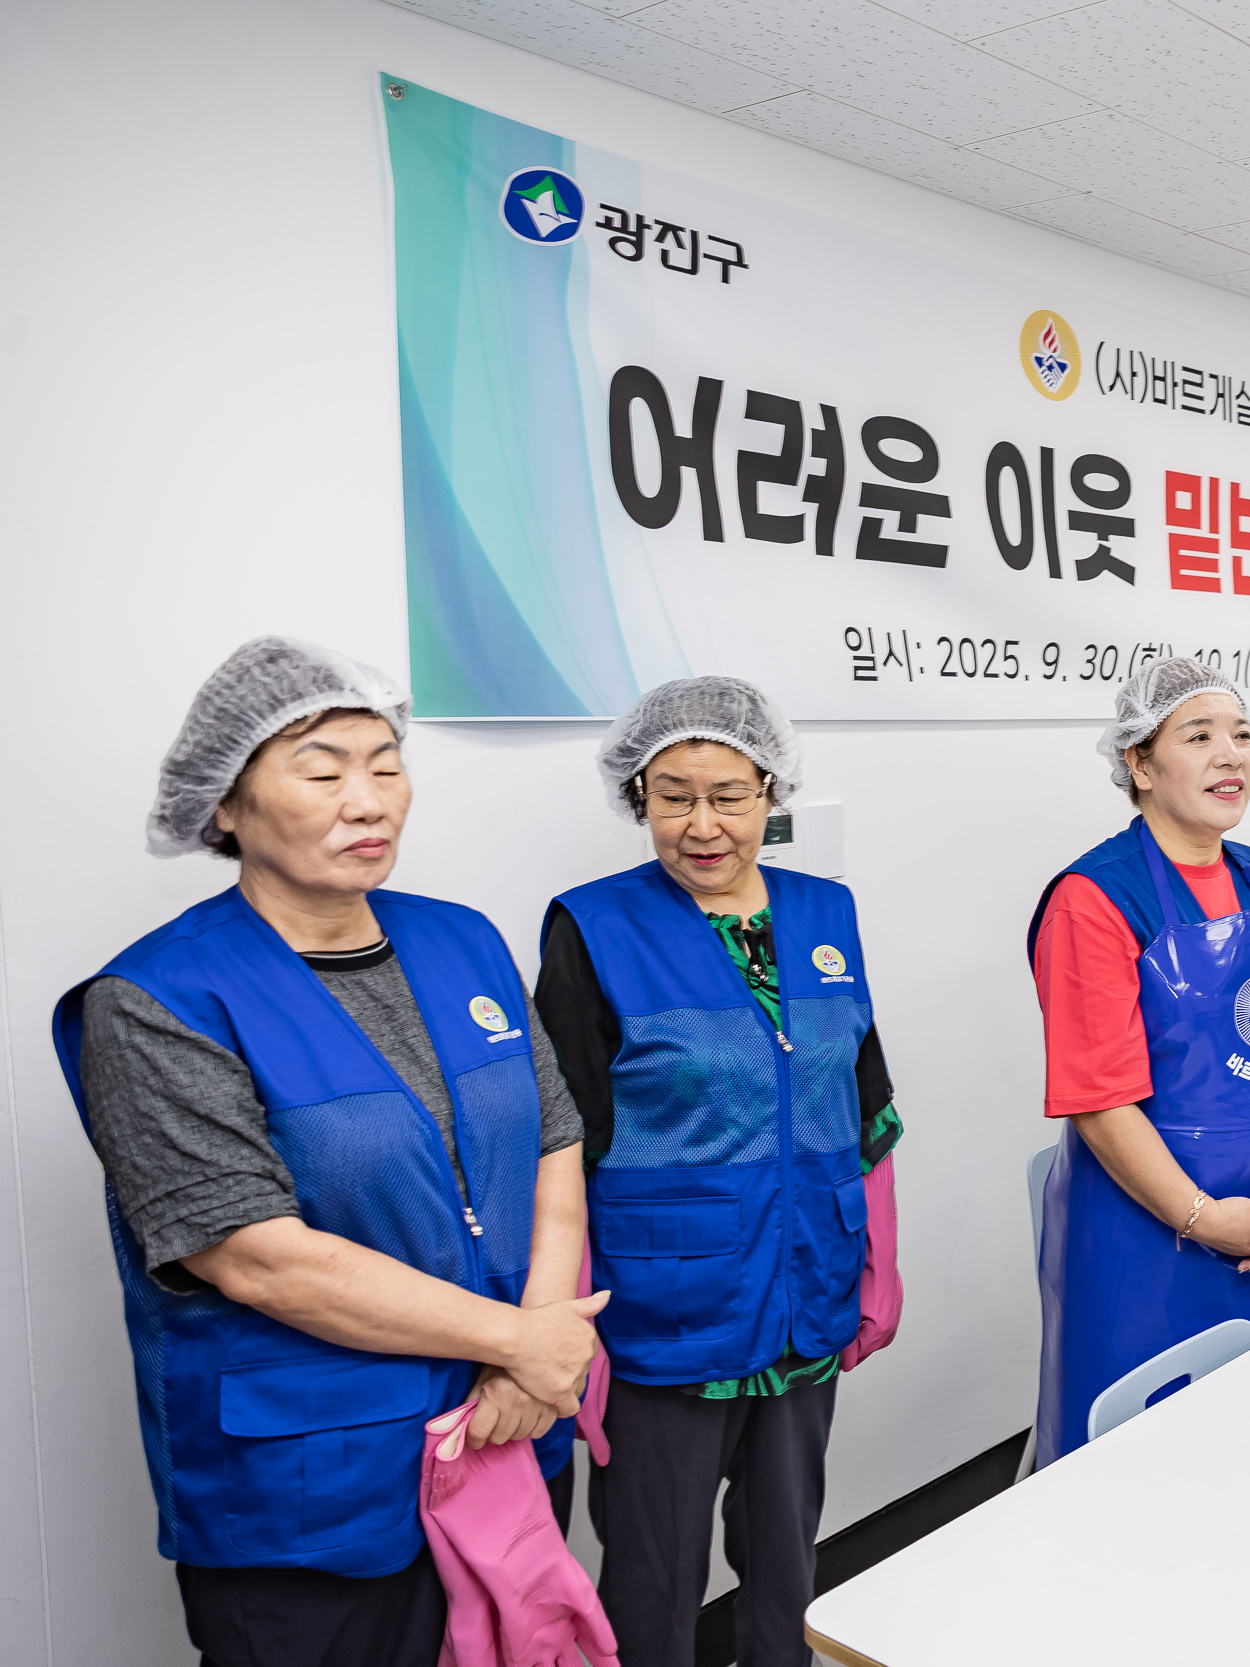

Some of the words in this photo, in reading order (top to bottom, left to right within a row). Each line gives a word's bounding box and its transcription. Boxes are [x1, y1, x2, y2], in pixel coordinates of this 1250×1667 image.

[596, 202, 750, 285] 광진구
[608, 365, 953, 570] 어려운
[985, 441, 1137, 587] 이웃
[844, 626, 925, 683] 일시:
[937, 637, 1031, 683] 2025.
[1043, 642, 1068, 683] 9.
